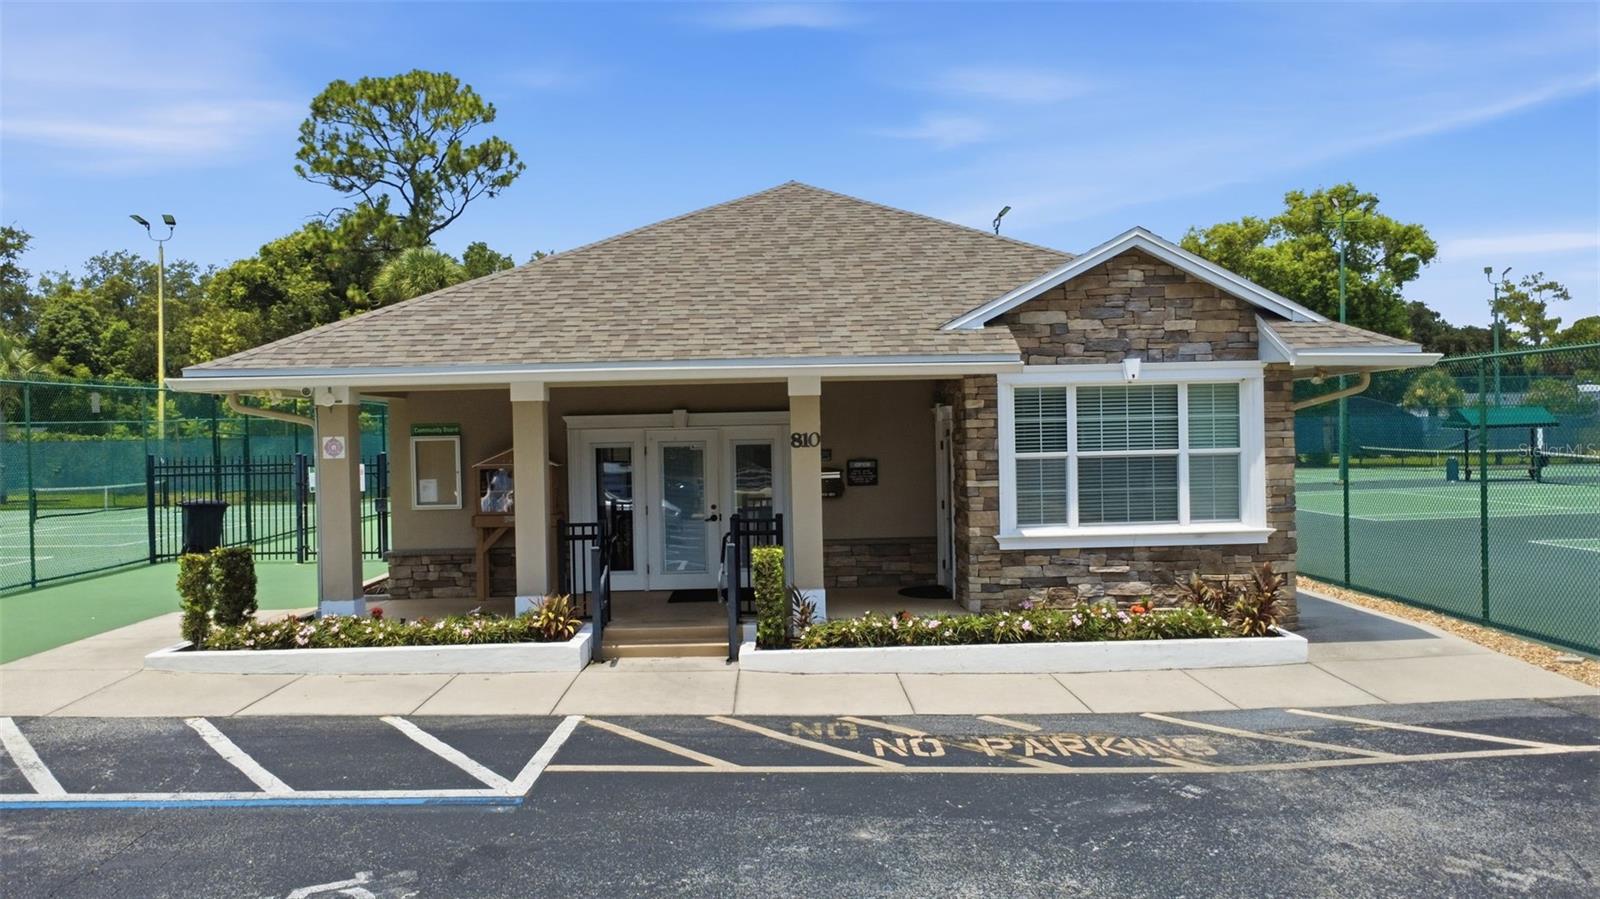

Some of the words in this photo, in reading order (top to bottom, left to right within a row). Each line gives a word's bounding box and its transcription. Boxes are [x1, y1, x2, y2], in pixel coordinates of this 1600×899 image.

[791, 432, 821, 448] 810
[790, 721, 859, 740] NO
[872, 737, 946, 757] NO
[976, 735, 1218, 757] PARKING
